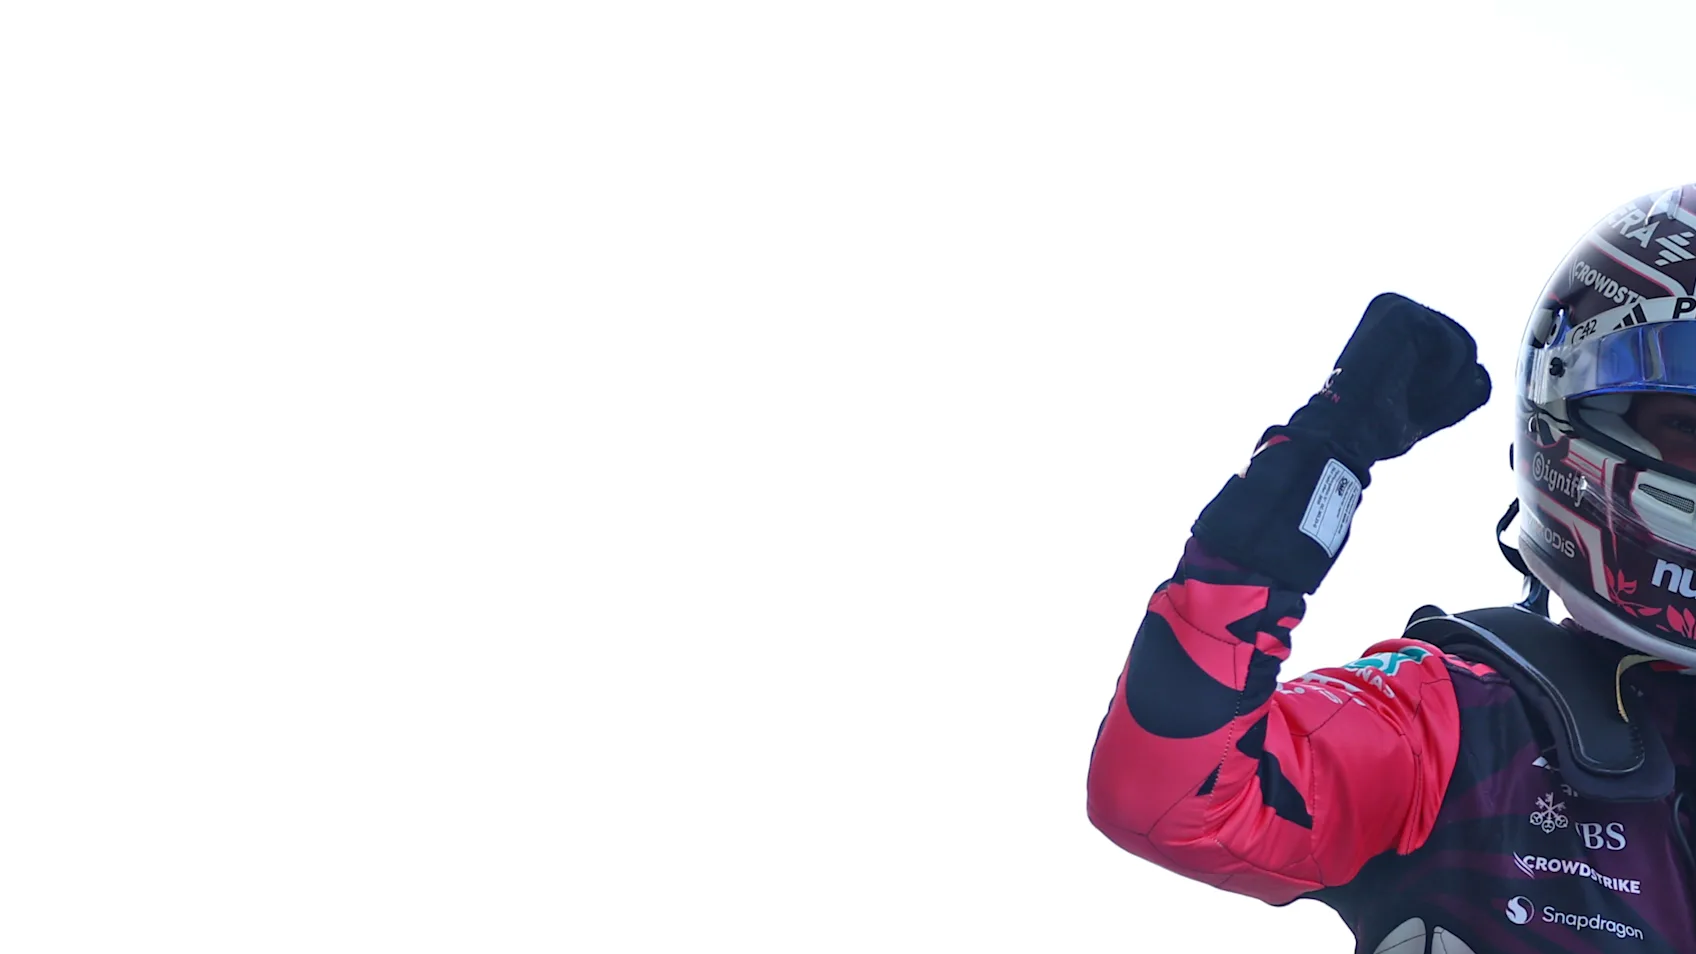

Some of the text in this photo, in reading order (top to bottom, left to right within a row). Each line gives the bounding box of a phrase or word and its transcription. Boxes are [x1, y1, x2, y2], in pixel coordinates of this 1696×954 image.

[1575, 821, 1627, 850] BS
[1521, 854, 1641, 895] CROWDSTRIKE
[1542, 905, 1644, 940] Snapdragon
